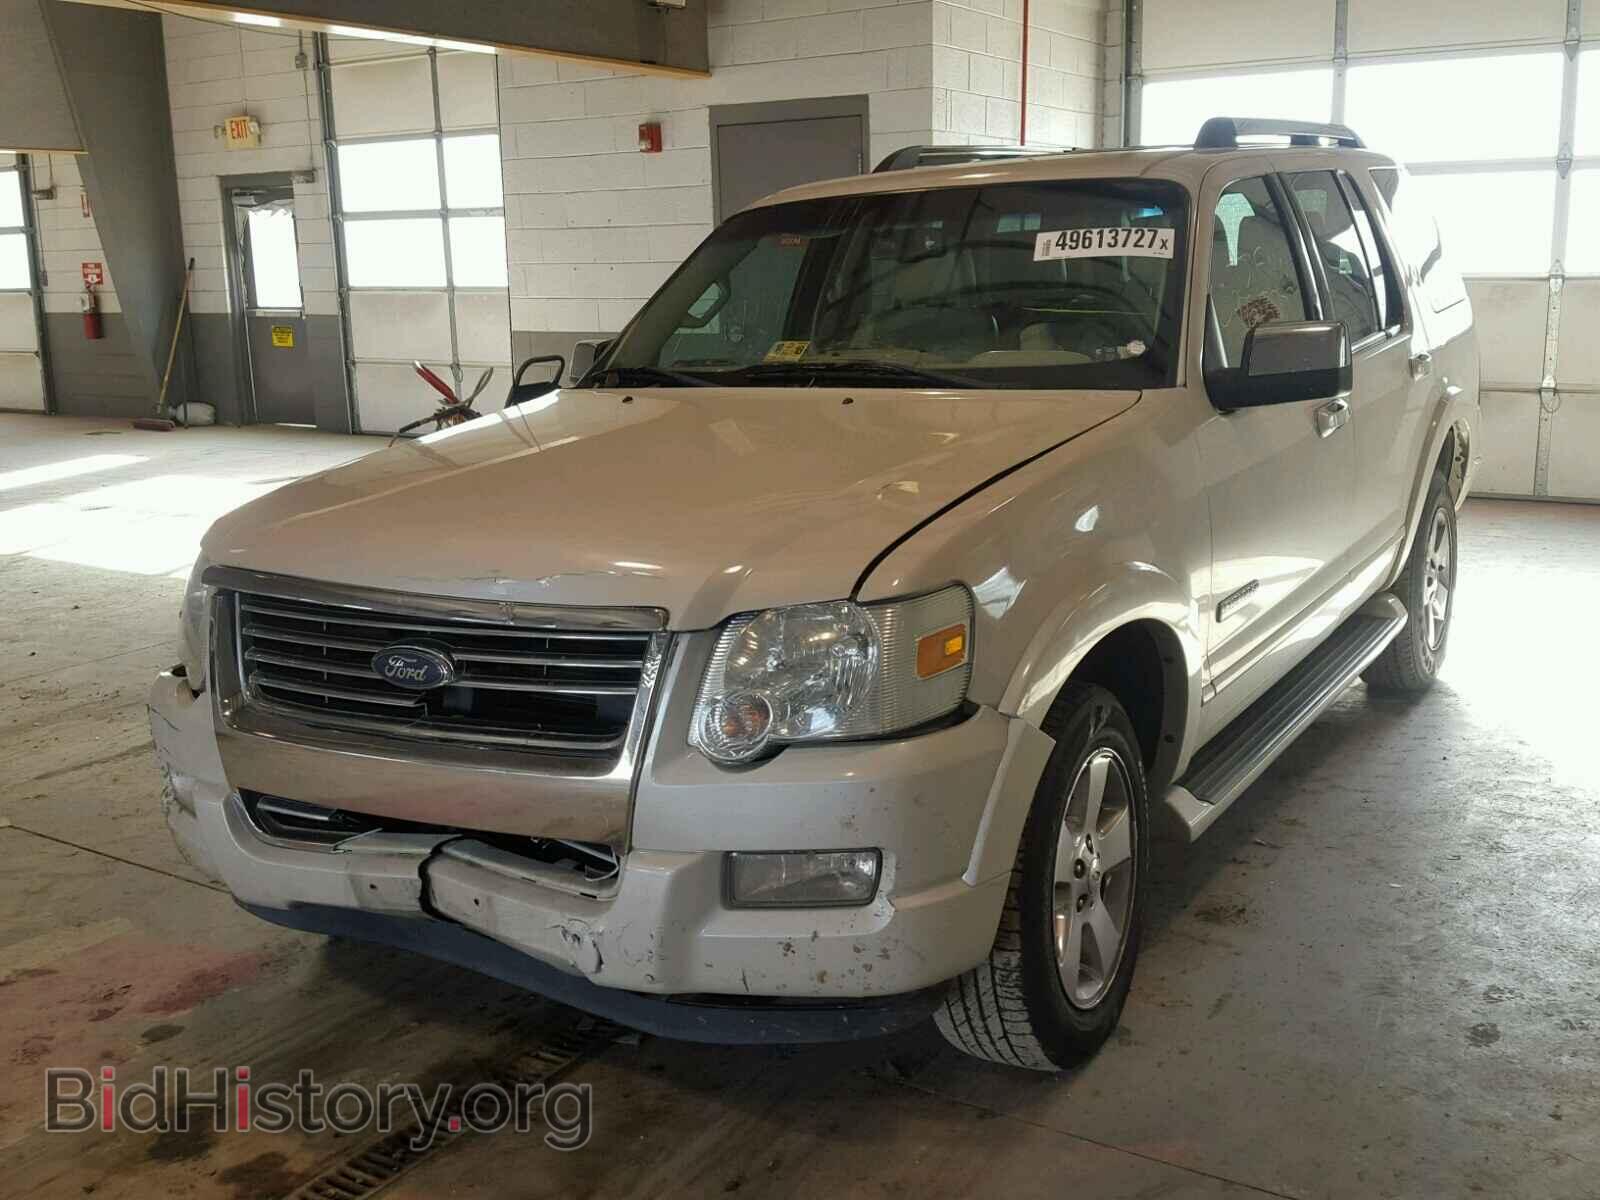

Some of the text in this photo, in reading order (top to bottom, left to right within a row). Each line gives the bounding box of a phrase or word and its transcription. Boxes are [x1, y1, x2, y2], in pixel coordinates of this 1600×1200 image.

[231, 119, 249, 139] EXIT
[1055, 228, 1159, 250] 49613727
[384, 655, 428, 681] Ford
